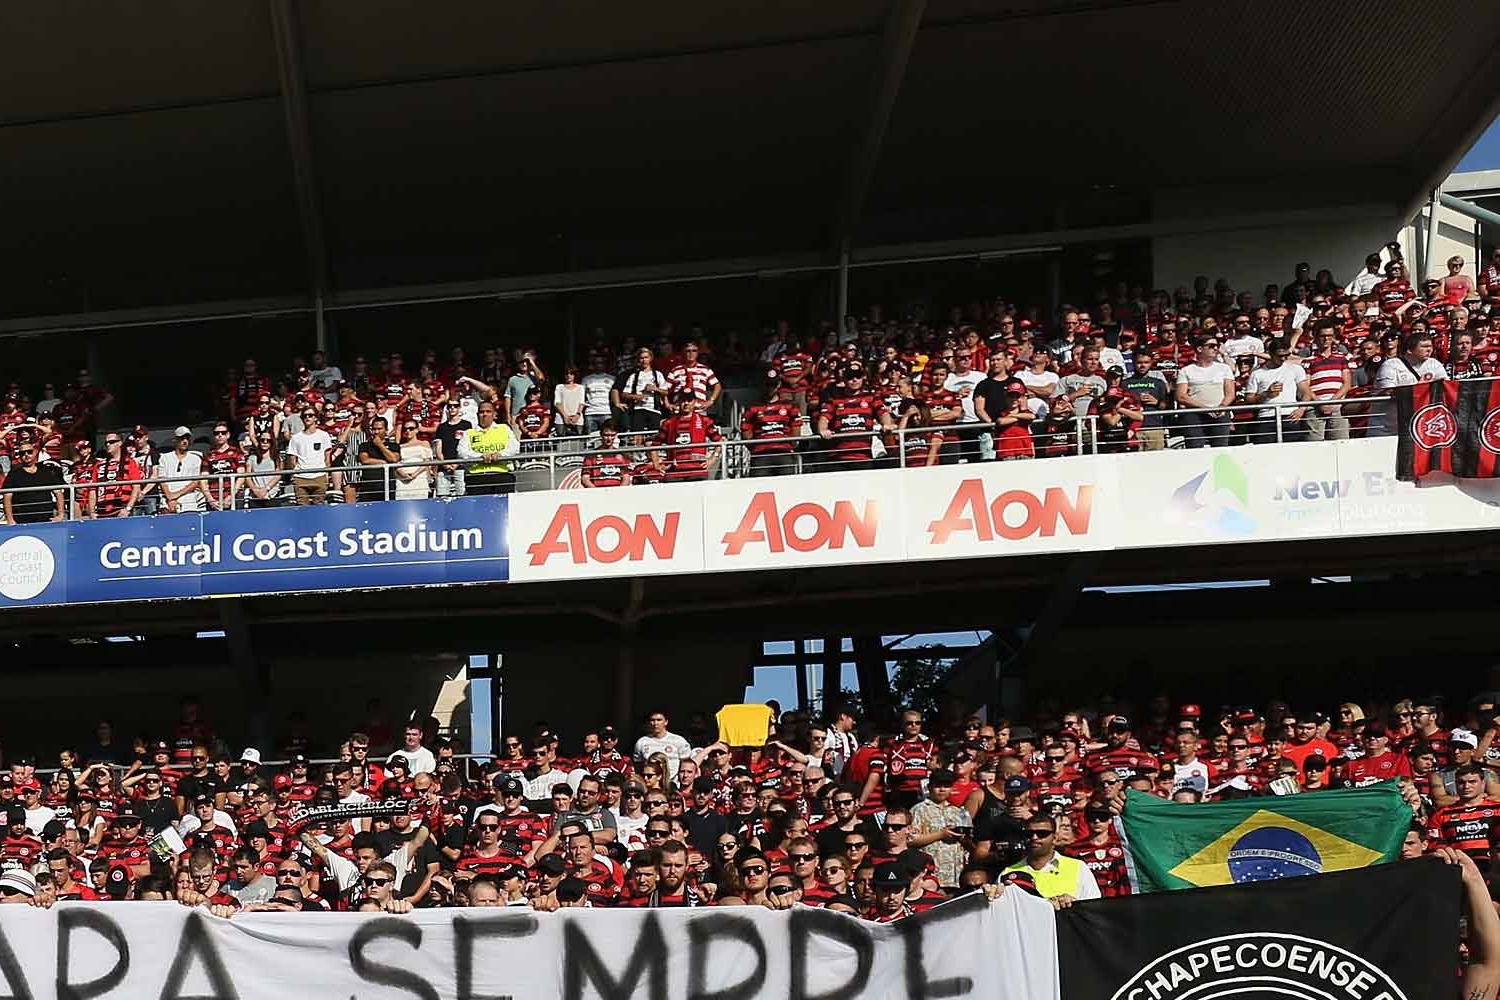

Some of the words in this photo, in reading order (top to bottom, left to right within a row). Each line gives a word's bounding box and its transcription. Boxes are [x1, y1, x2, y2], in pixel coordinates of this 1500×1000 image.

[100, 534, 221, 569] Central
[232, 531, 328, 562] Coast
[339, 521, 483, 556] Stadium
[526, 503, 681, 567] AON
